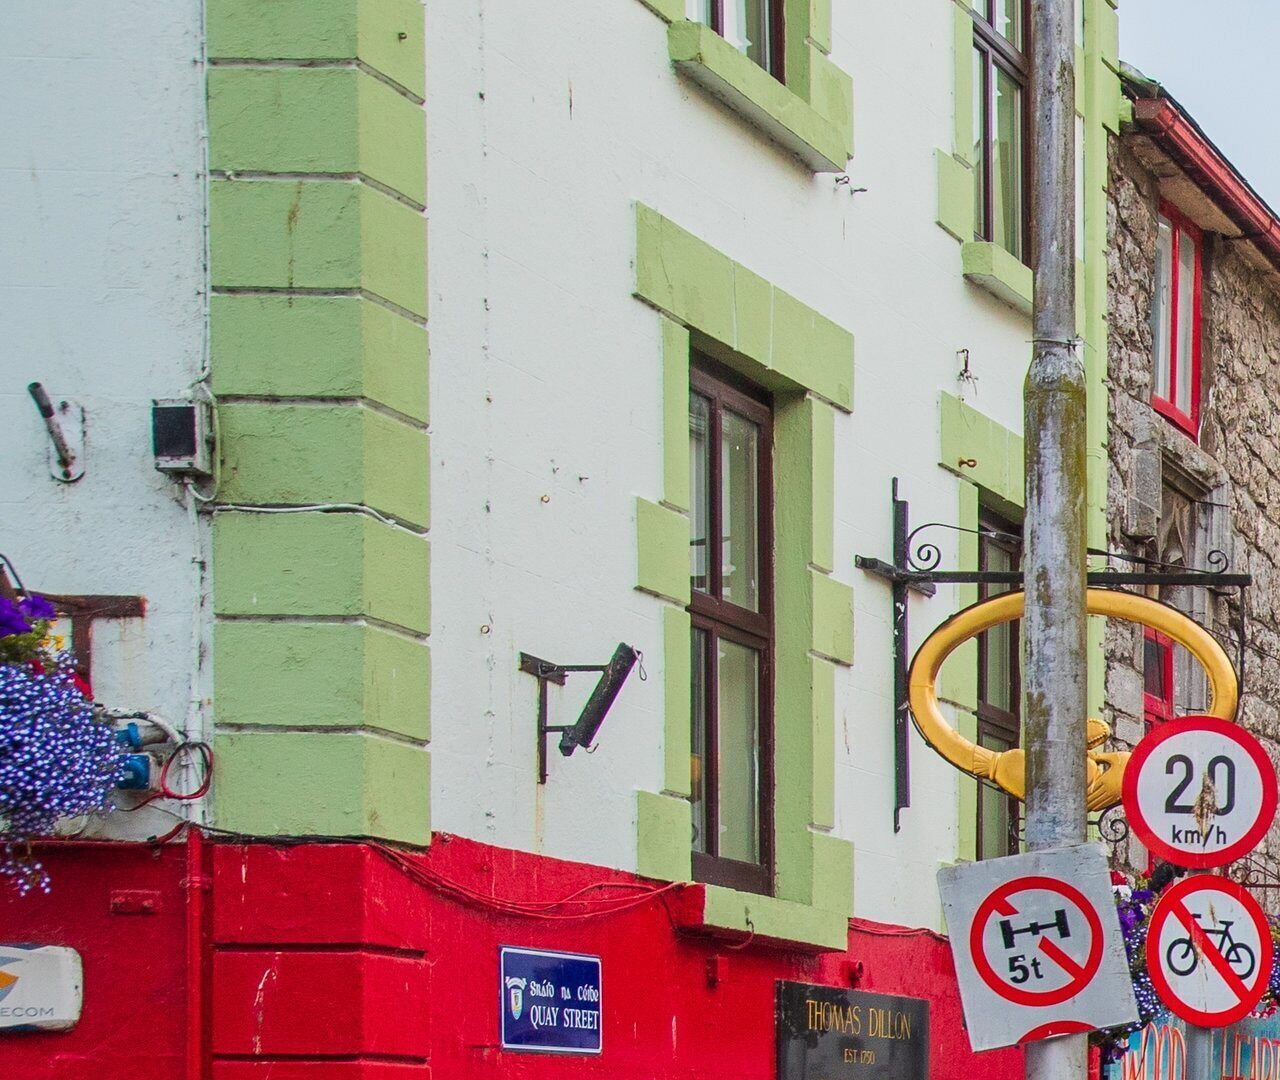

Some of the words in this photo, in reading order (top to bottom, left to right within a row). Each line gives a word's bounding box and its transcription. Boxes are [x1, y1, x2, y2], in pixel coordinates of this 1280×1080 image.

[1165, 754, 1235, 816] 20
[1171, 824, 1227, 847] km/h
[1008, 954, 1044, 984] 5t
[530, 1005, 559, 1029] QUAY
[563, 1008, 599, 1030] STREET
[806, 1000, 861, 1035] THOMAS
[868, 1008, 911, 1040] DILLON
[844, 1049, 857, 1064] EST
